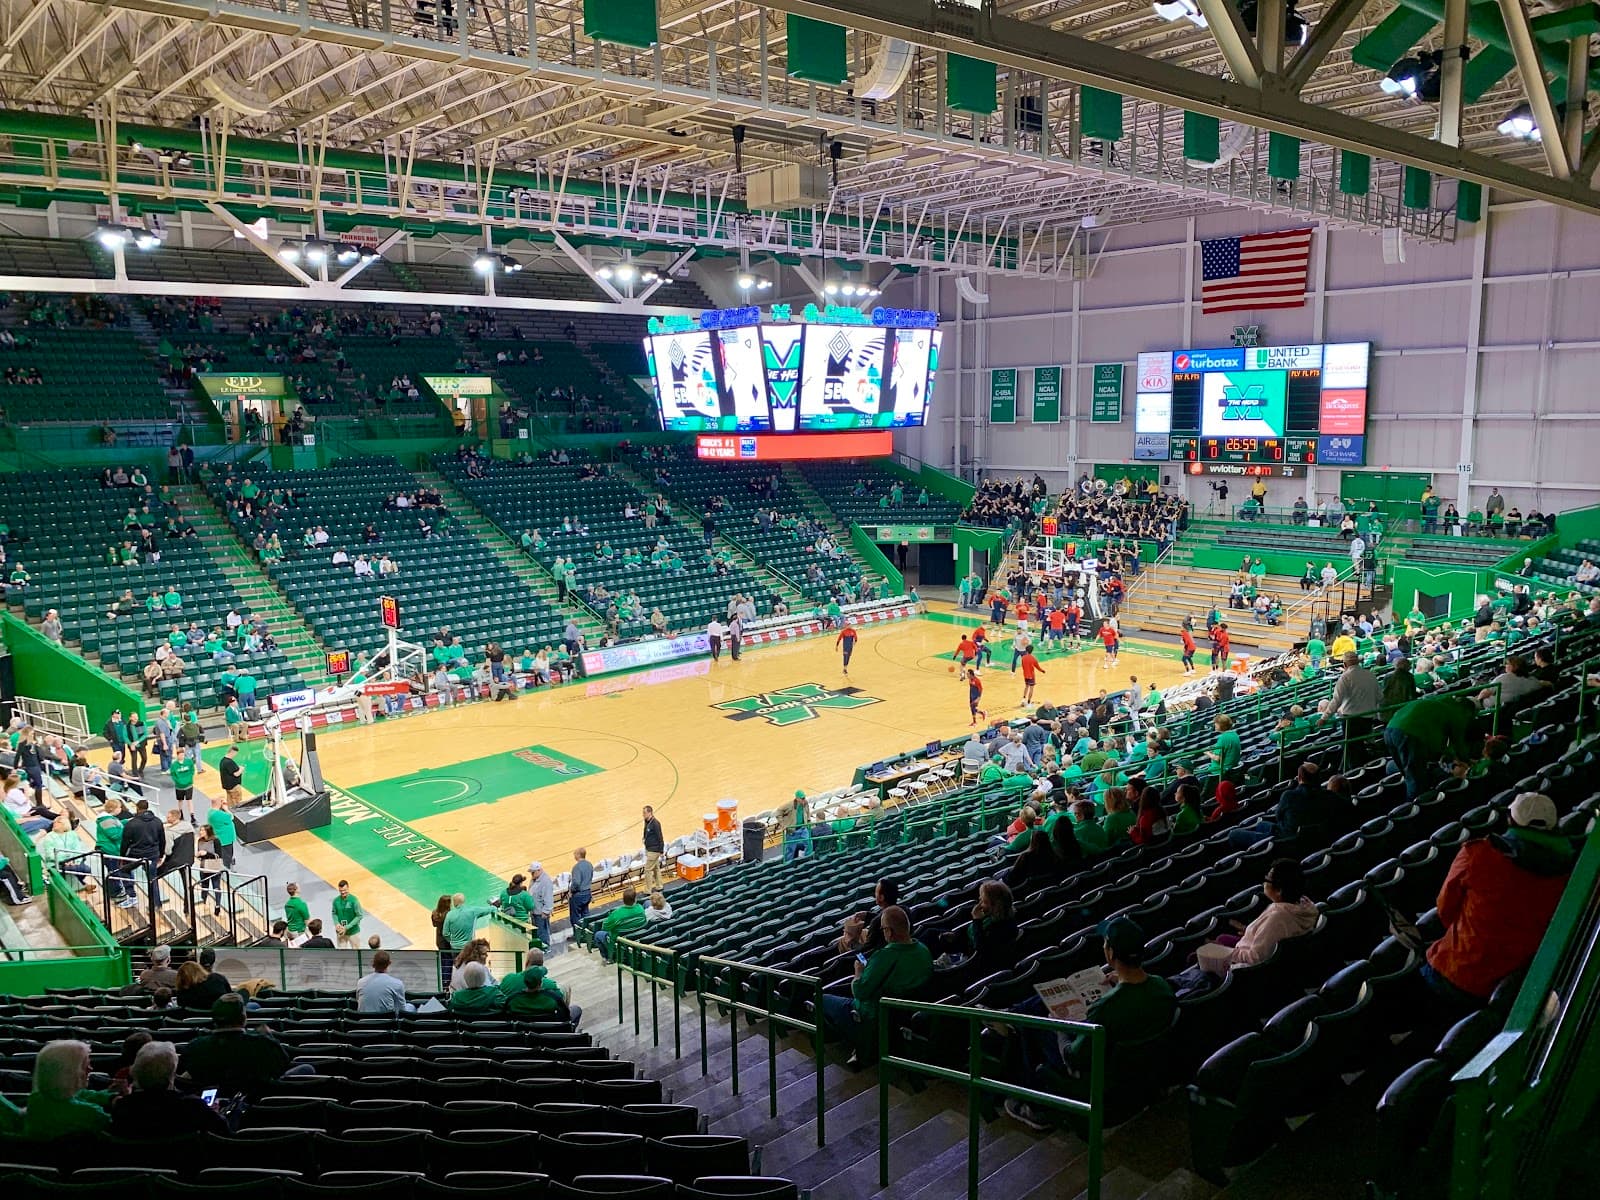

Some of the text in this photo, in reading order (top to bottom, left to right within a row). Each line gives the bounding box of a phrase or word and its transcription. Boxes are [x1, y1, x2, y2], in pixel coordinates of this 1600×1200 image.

[1268, 347, 1310, 357] UNITED
[1190, 357, 1239, 369] turbotax
[1268, 358, 1298, 368] BANK
[1145, 378, 1163, 387] KIA
[1137, 436, 1151, 446] AIR
[1190, 439, 1196, 448] 4
[1226, 438, 1257, 450] 26:59
[1308, 440, 1315, 449] 4
[1190, 450, 1196, 459] 0
[1210, 446, 1218, 458] 0
[1274, 447, 1282, 459] 0
[1307, 452, 1315, 462] 0
[1209, 465, 1272, 476] wvlottery.com
[1458, 464, 1472, 472] 115
[1043, 524, 1055, 534] 30
[332, 661, 345, 671] 30
